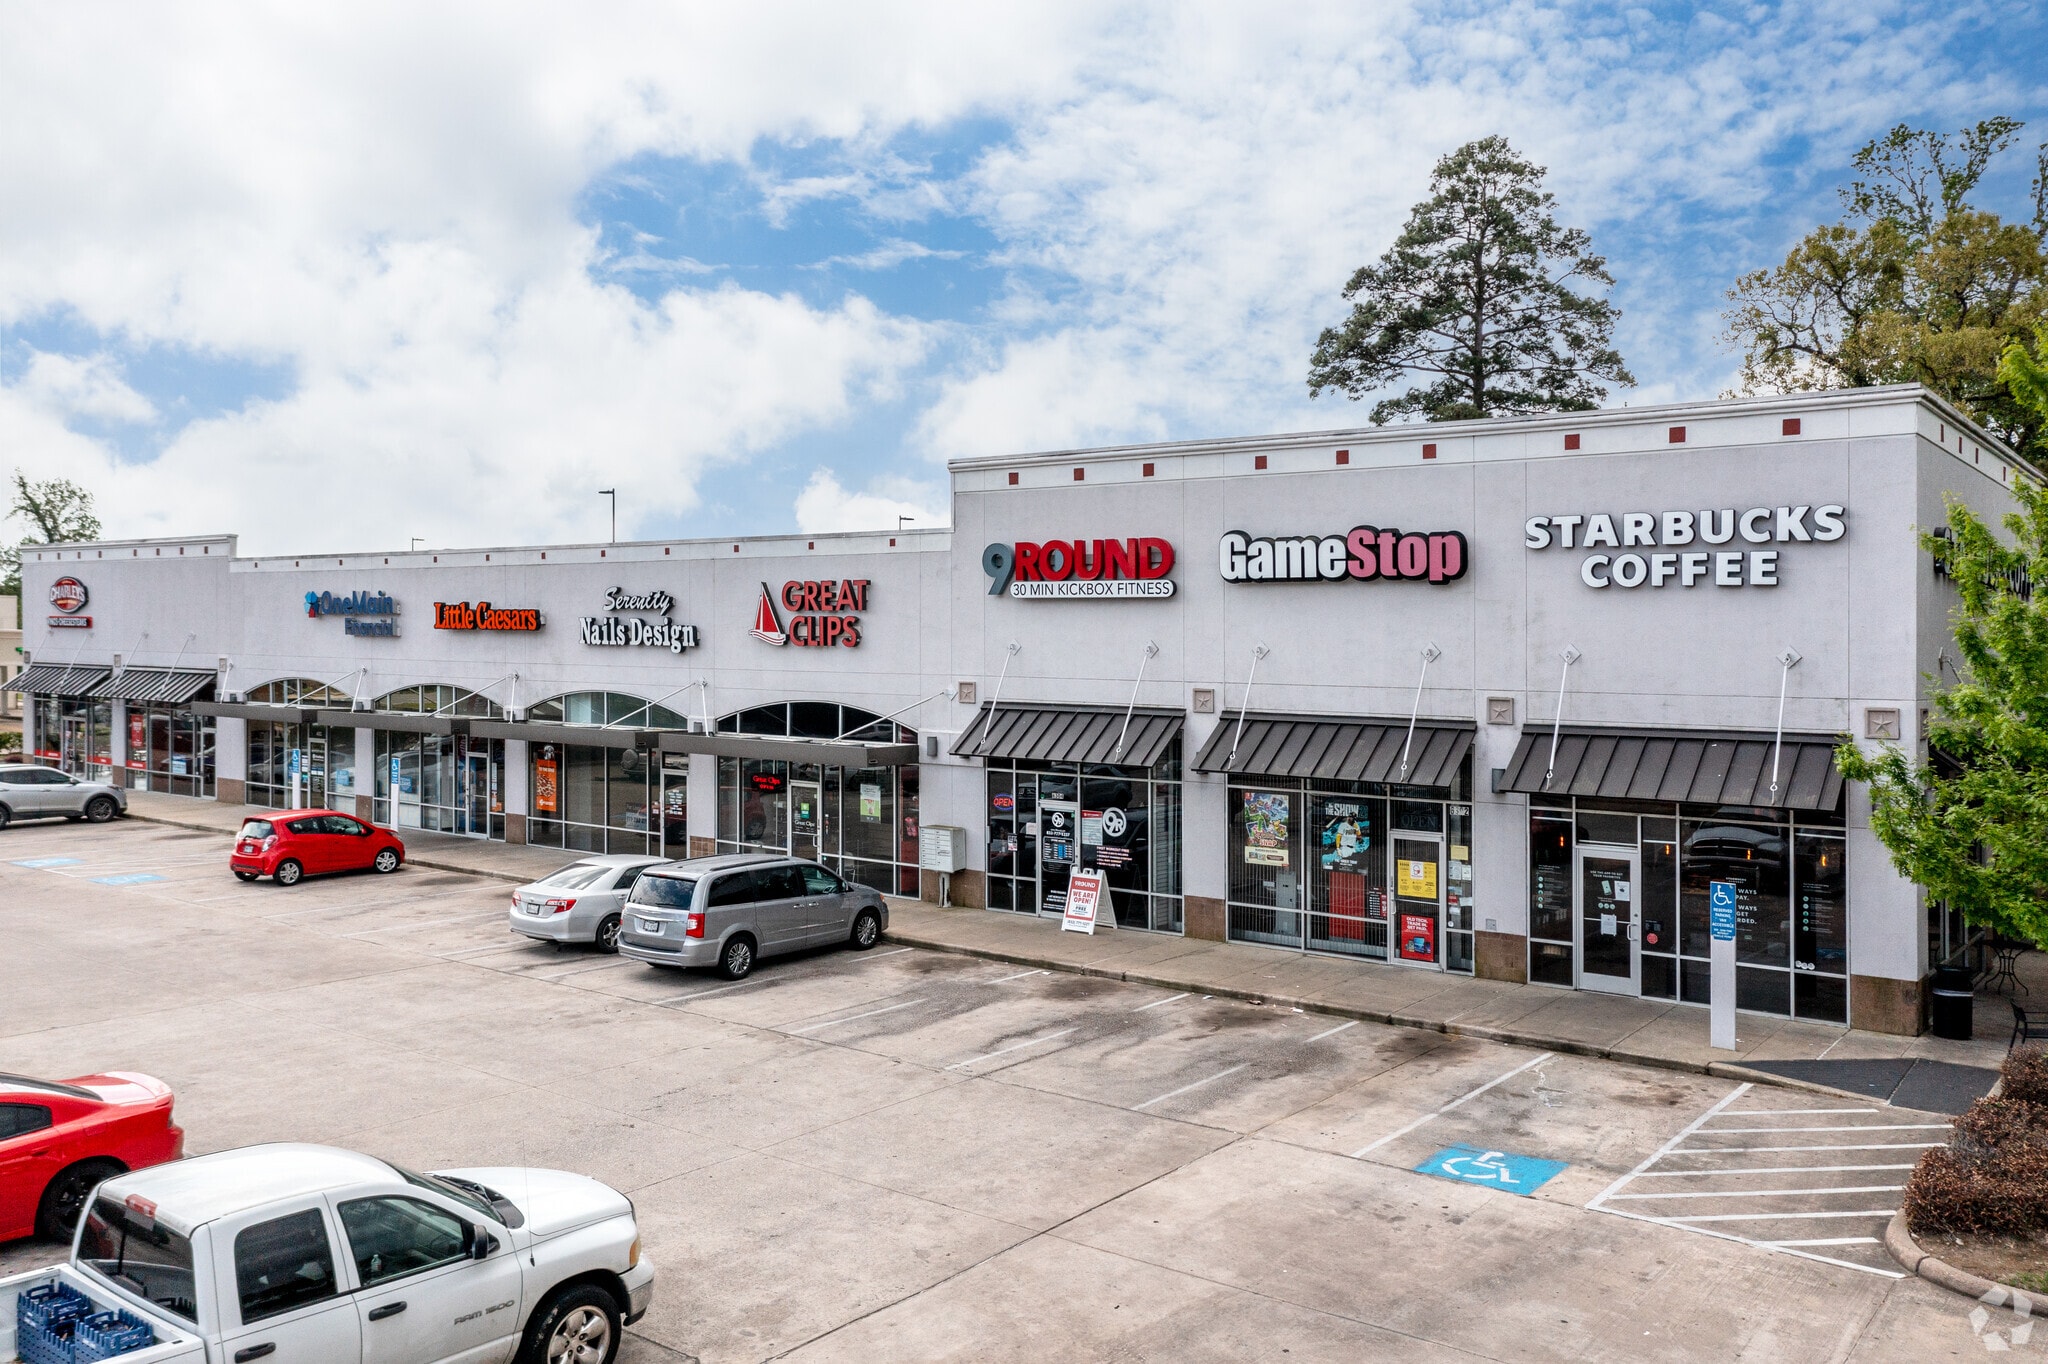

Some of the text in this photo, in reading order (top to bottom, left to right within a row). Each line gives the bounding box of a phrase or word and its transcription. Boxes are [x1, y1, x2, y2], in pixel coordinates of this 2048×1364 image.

[1525, 504, 1846, 550] STARBUCKS
[1219, 528, 1461, 582] GameStop
[1581, 551, 1779, 588] COFFEE
[321, 590, 394, 614] OneMain
[603, 586, 671, 616] Serenity
[781, 579, 868, 611] GREAT
[1013, 582, 1170, 596] 30 MIN KICKBOX FITNESS
[433, 601, 537, 631] Little Caesars
[789, 615, 858, 647] CLIPS
[580, 617, 696, 653] Nails Design
[993, 797, 1015, 807] OPEN
[1334, 803, 1359, 817] SHOW
[1401, 814, 1438, 829] OPEN
[1738, 904, 1757, 912] WAYS
[485, 1300, 515, 1315] 1500
